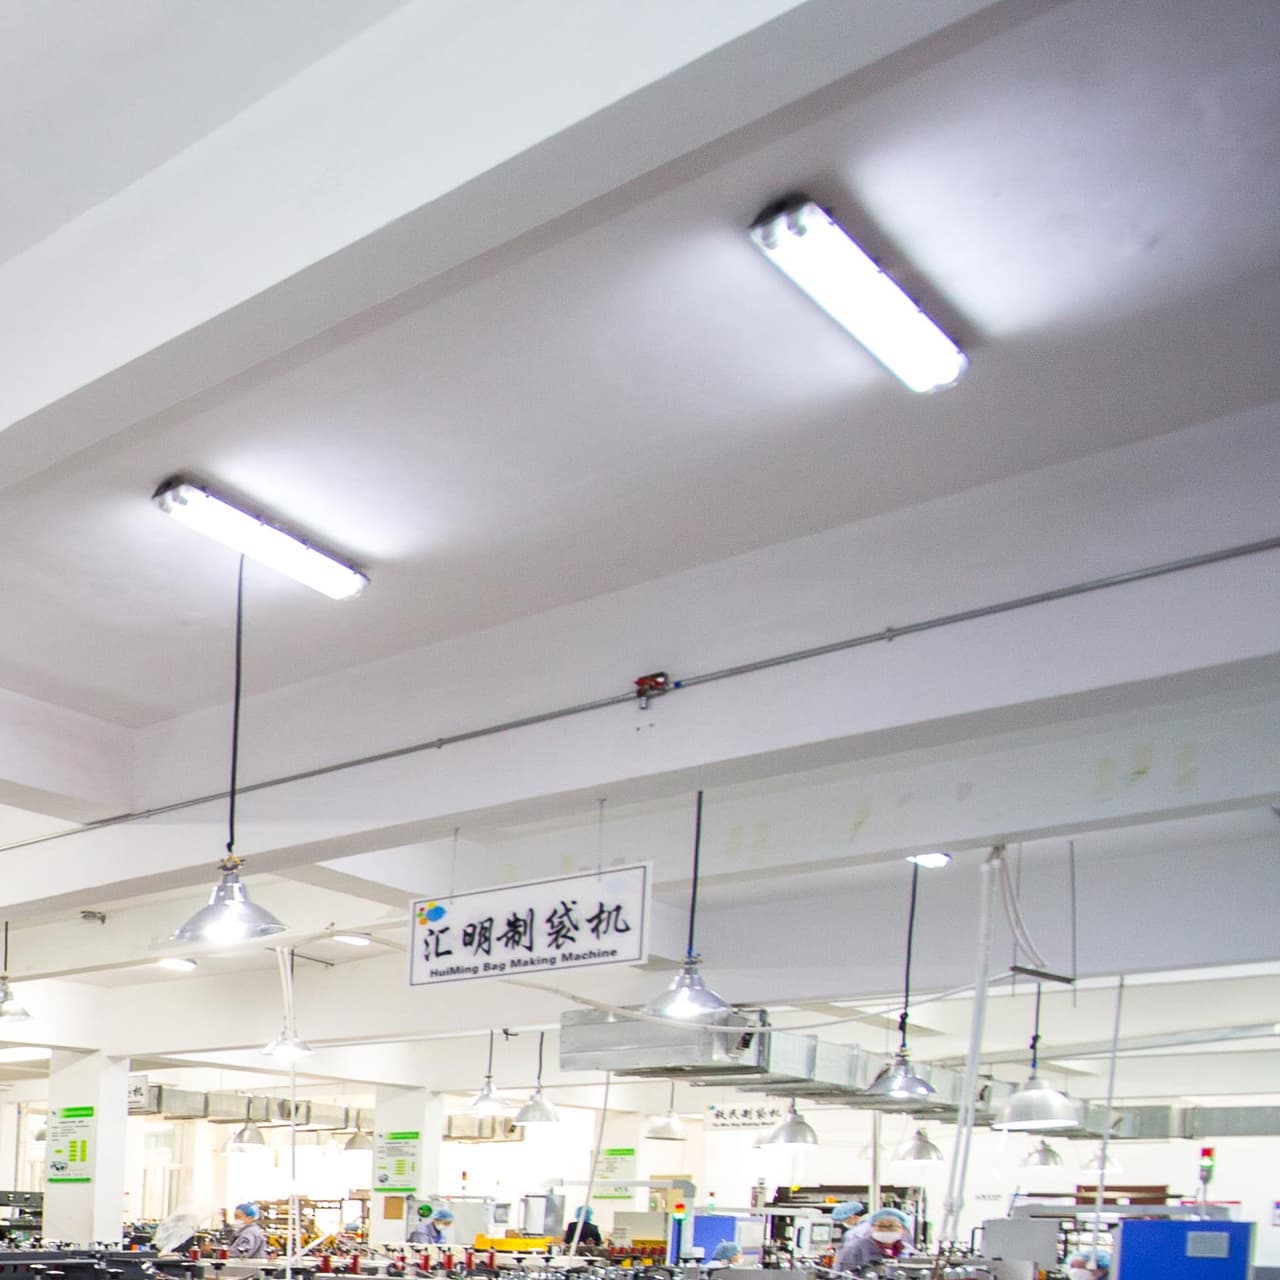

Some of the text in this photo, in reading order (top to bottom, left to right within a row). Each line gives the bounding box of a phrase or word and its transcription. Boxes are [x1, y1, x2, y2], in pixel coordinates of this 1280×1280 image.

[423, 901, 631, 962] 汇明制袋机
[430, 948, 618, 978] HuiMing Bag Making Machine
